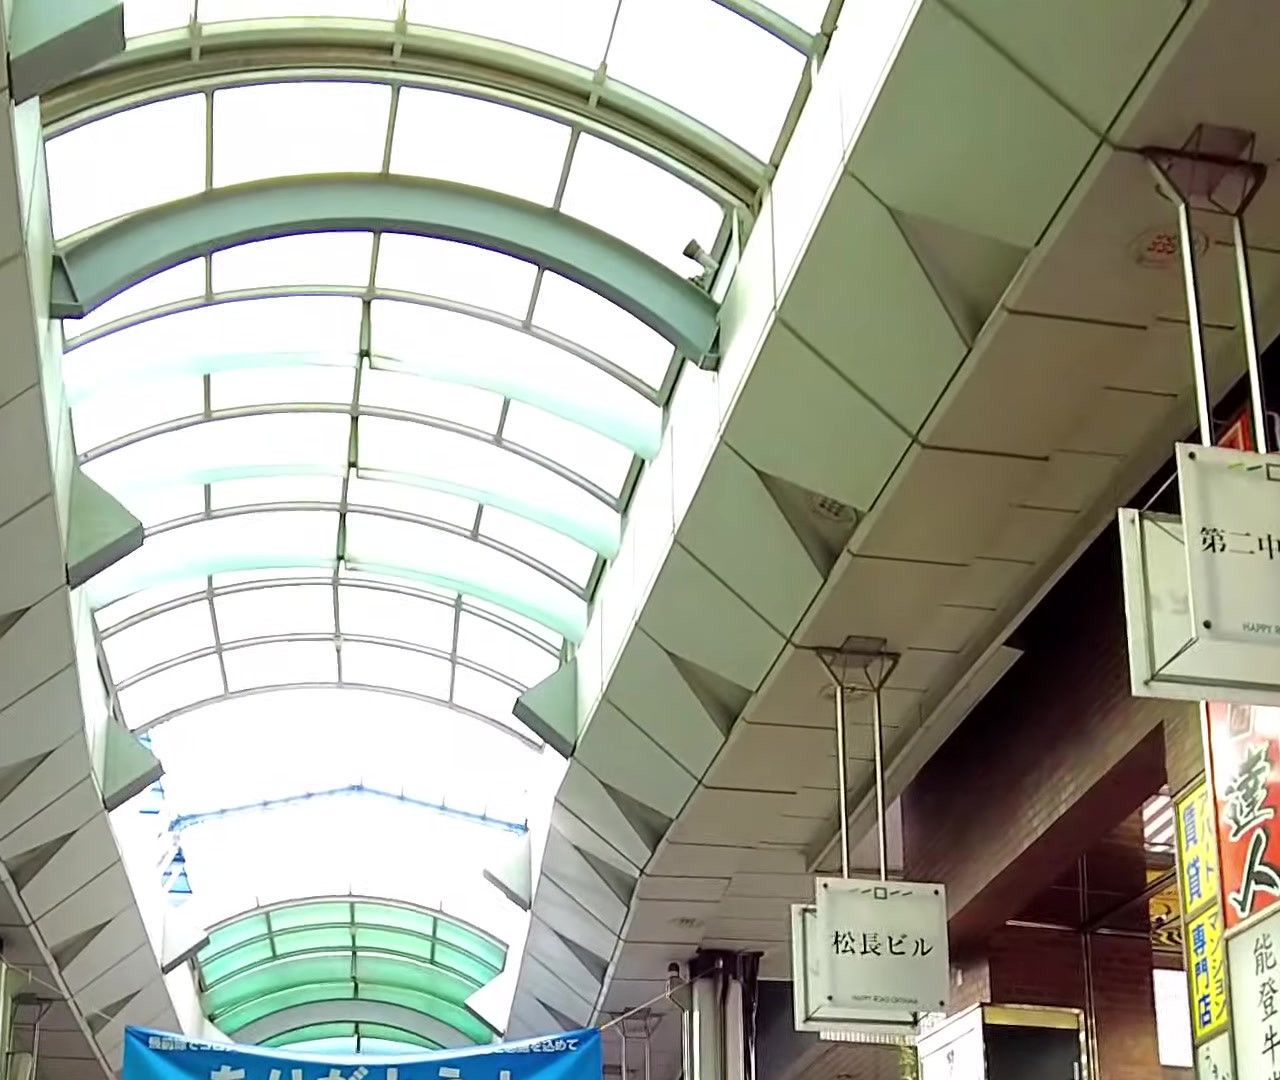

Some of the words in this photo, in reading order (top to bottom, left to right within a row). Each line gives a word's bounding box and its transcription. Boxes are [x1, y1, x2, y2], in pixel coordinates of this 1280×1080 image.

[1242, 621, 1272, 634] HAPPY
[831, 930, 934, 958] 松長ビル
